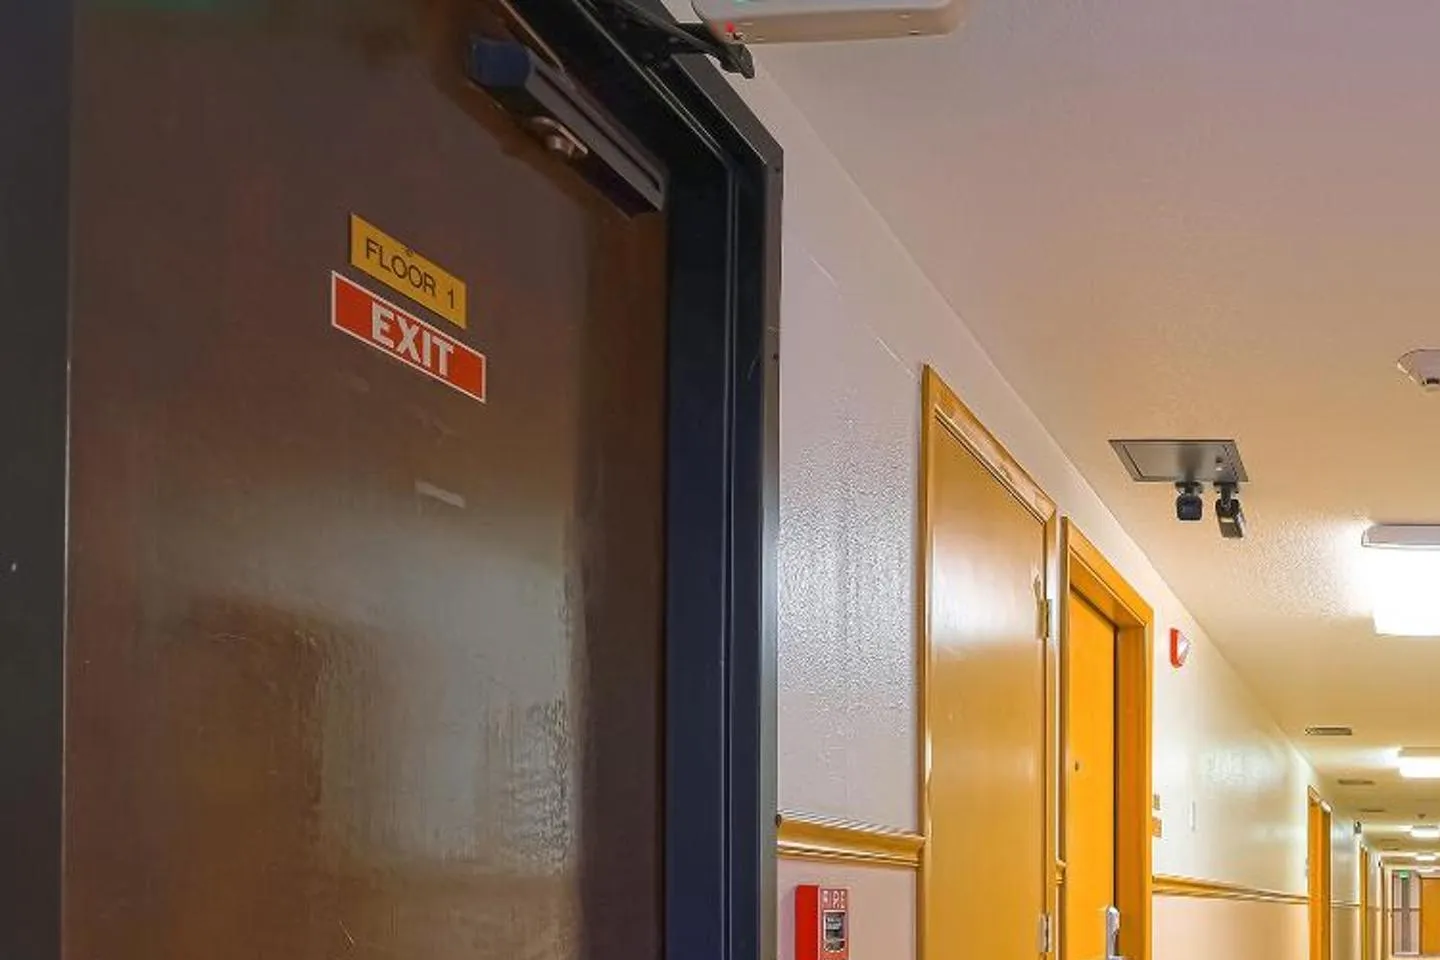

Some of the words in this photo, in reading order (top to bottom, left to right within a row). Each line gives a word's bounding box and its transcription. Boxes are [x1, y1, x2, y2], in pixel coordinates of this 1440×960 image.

[366, 238, 436, 297] FLOOR
[447, 288, 455, 310] 1
[371, 300, 454, 377] EXIT
